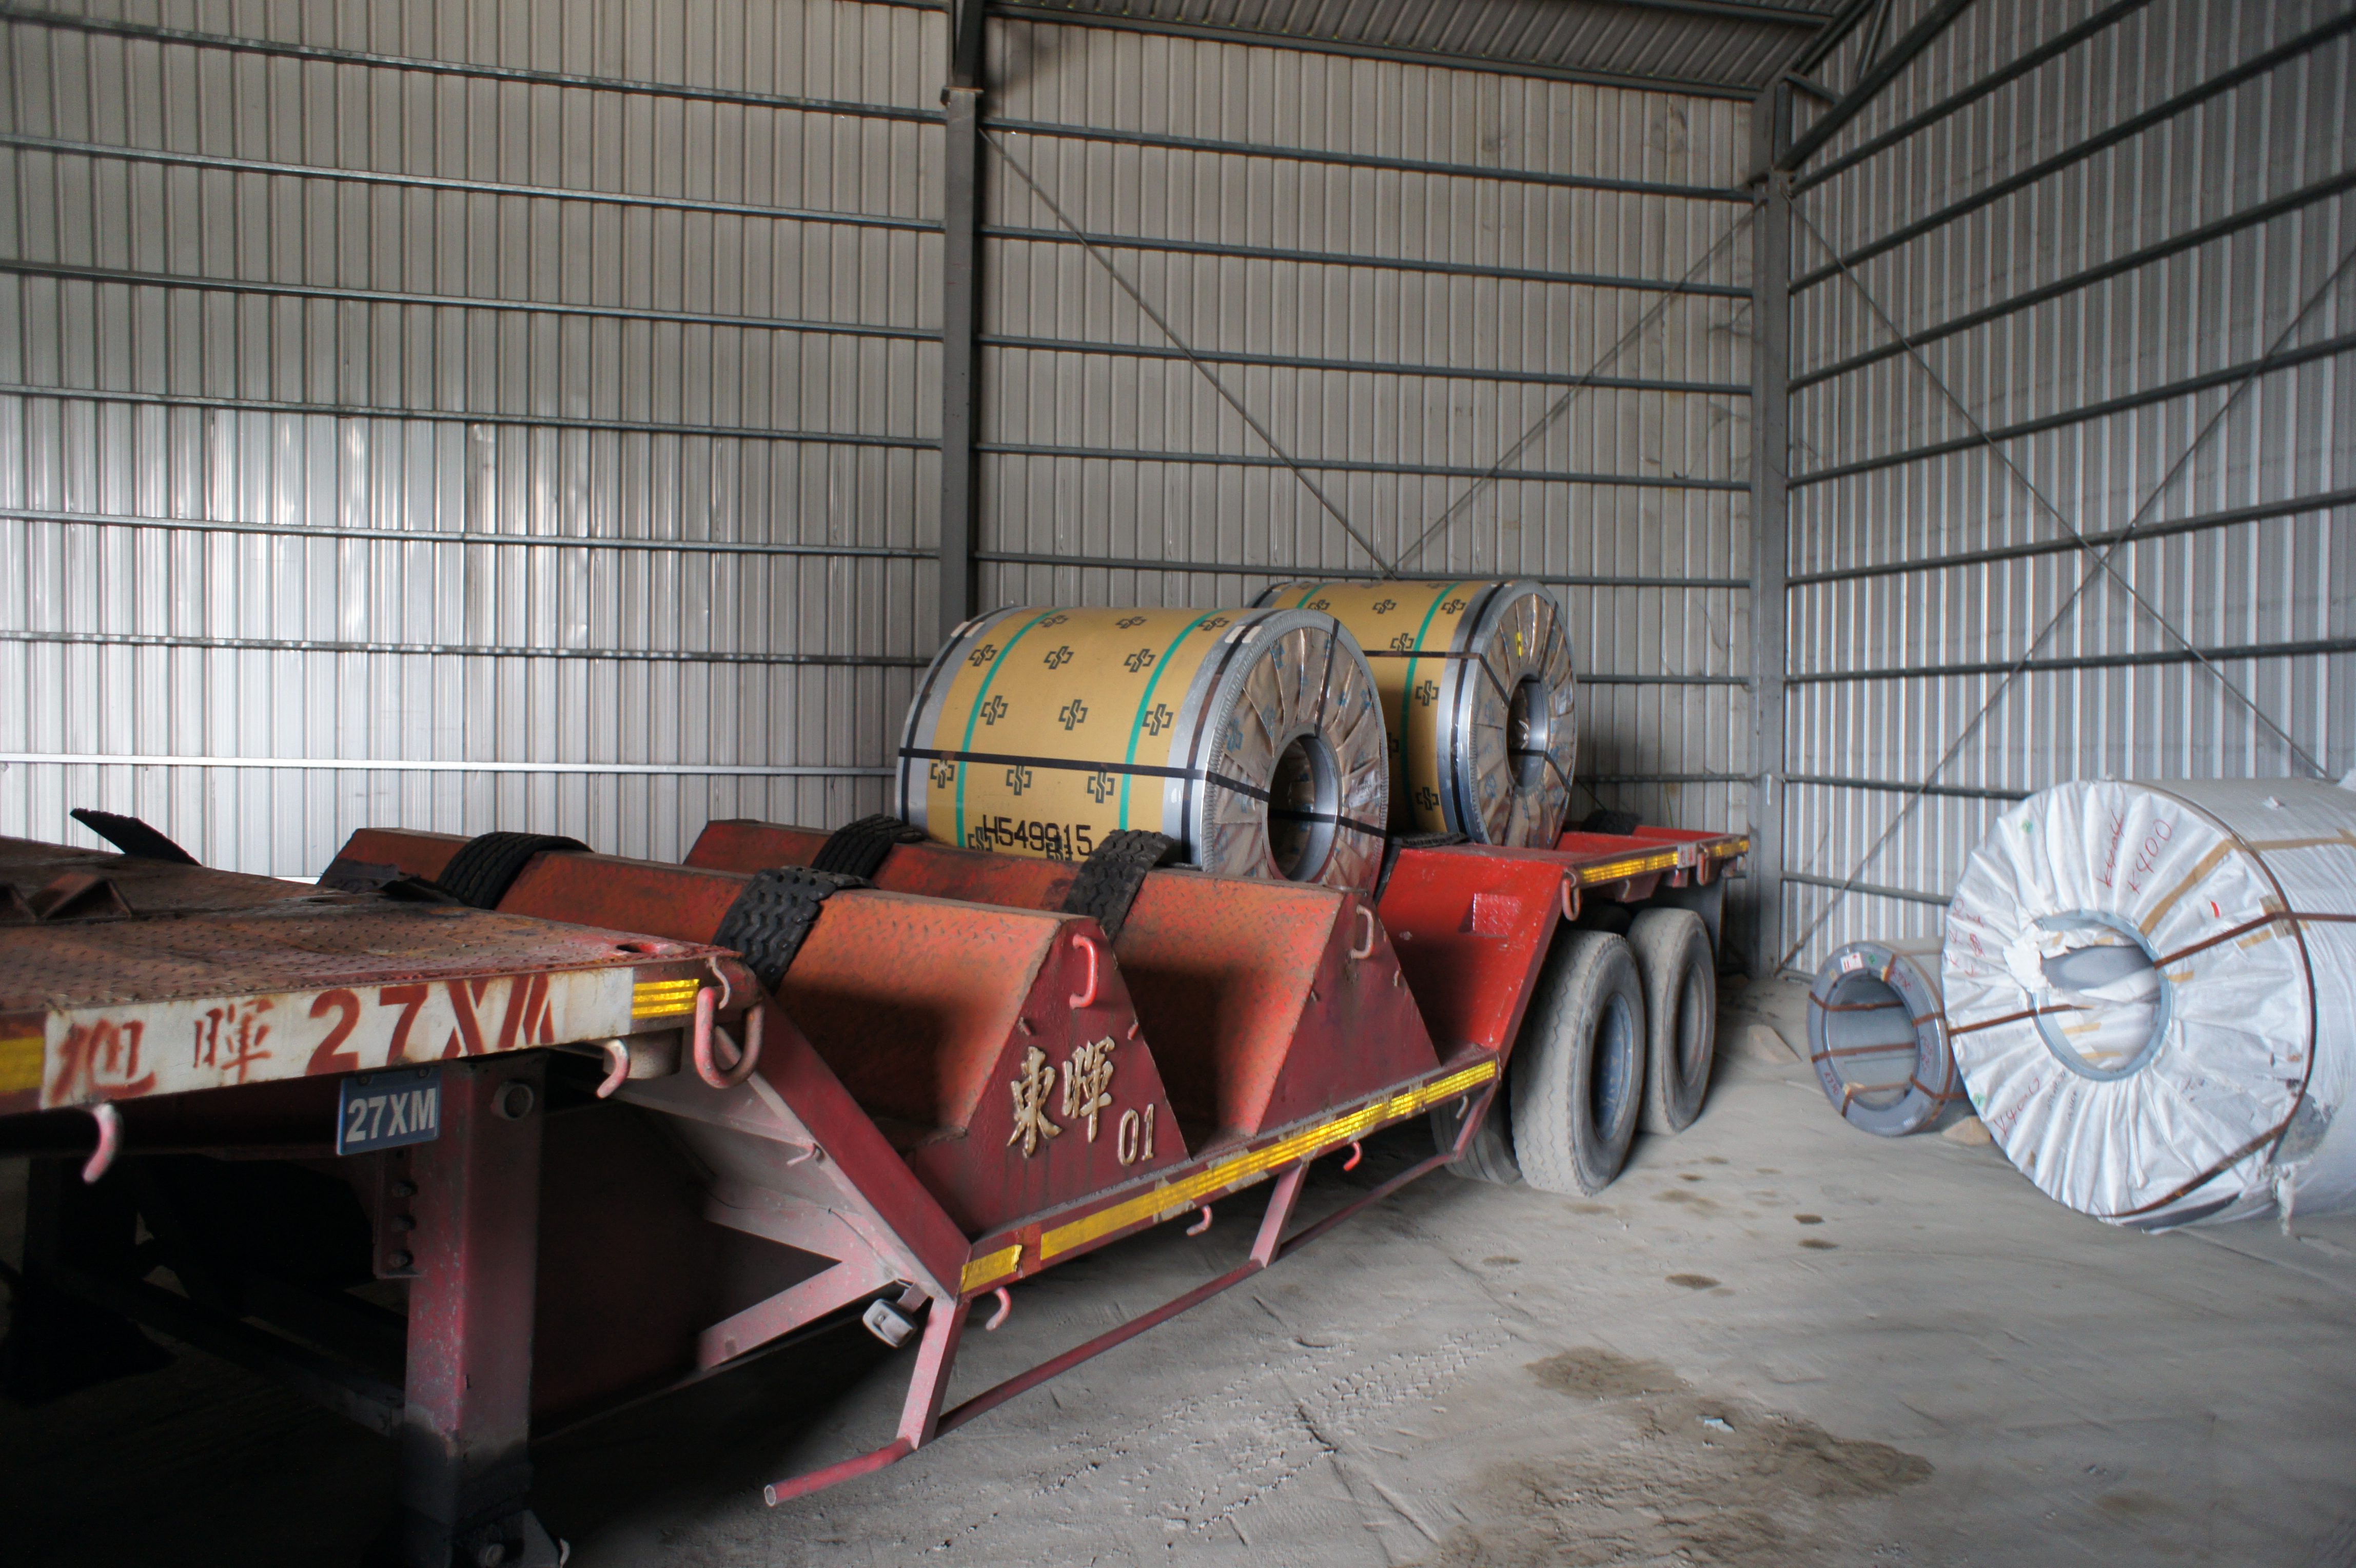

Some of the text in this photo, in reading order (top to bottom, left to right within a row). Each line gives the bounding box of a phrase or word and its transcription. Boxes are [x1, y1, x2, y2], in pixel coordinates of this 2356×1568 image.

[983, 814, 1092, 856] H549915
[2127, 819, 2172, 895] K400
[305, 973, 555, 1076] 27XM
[346, 1087, 437, 1143] 27XM
[1117, 1103, 1155, 1166] 01
